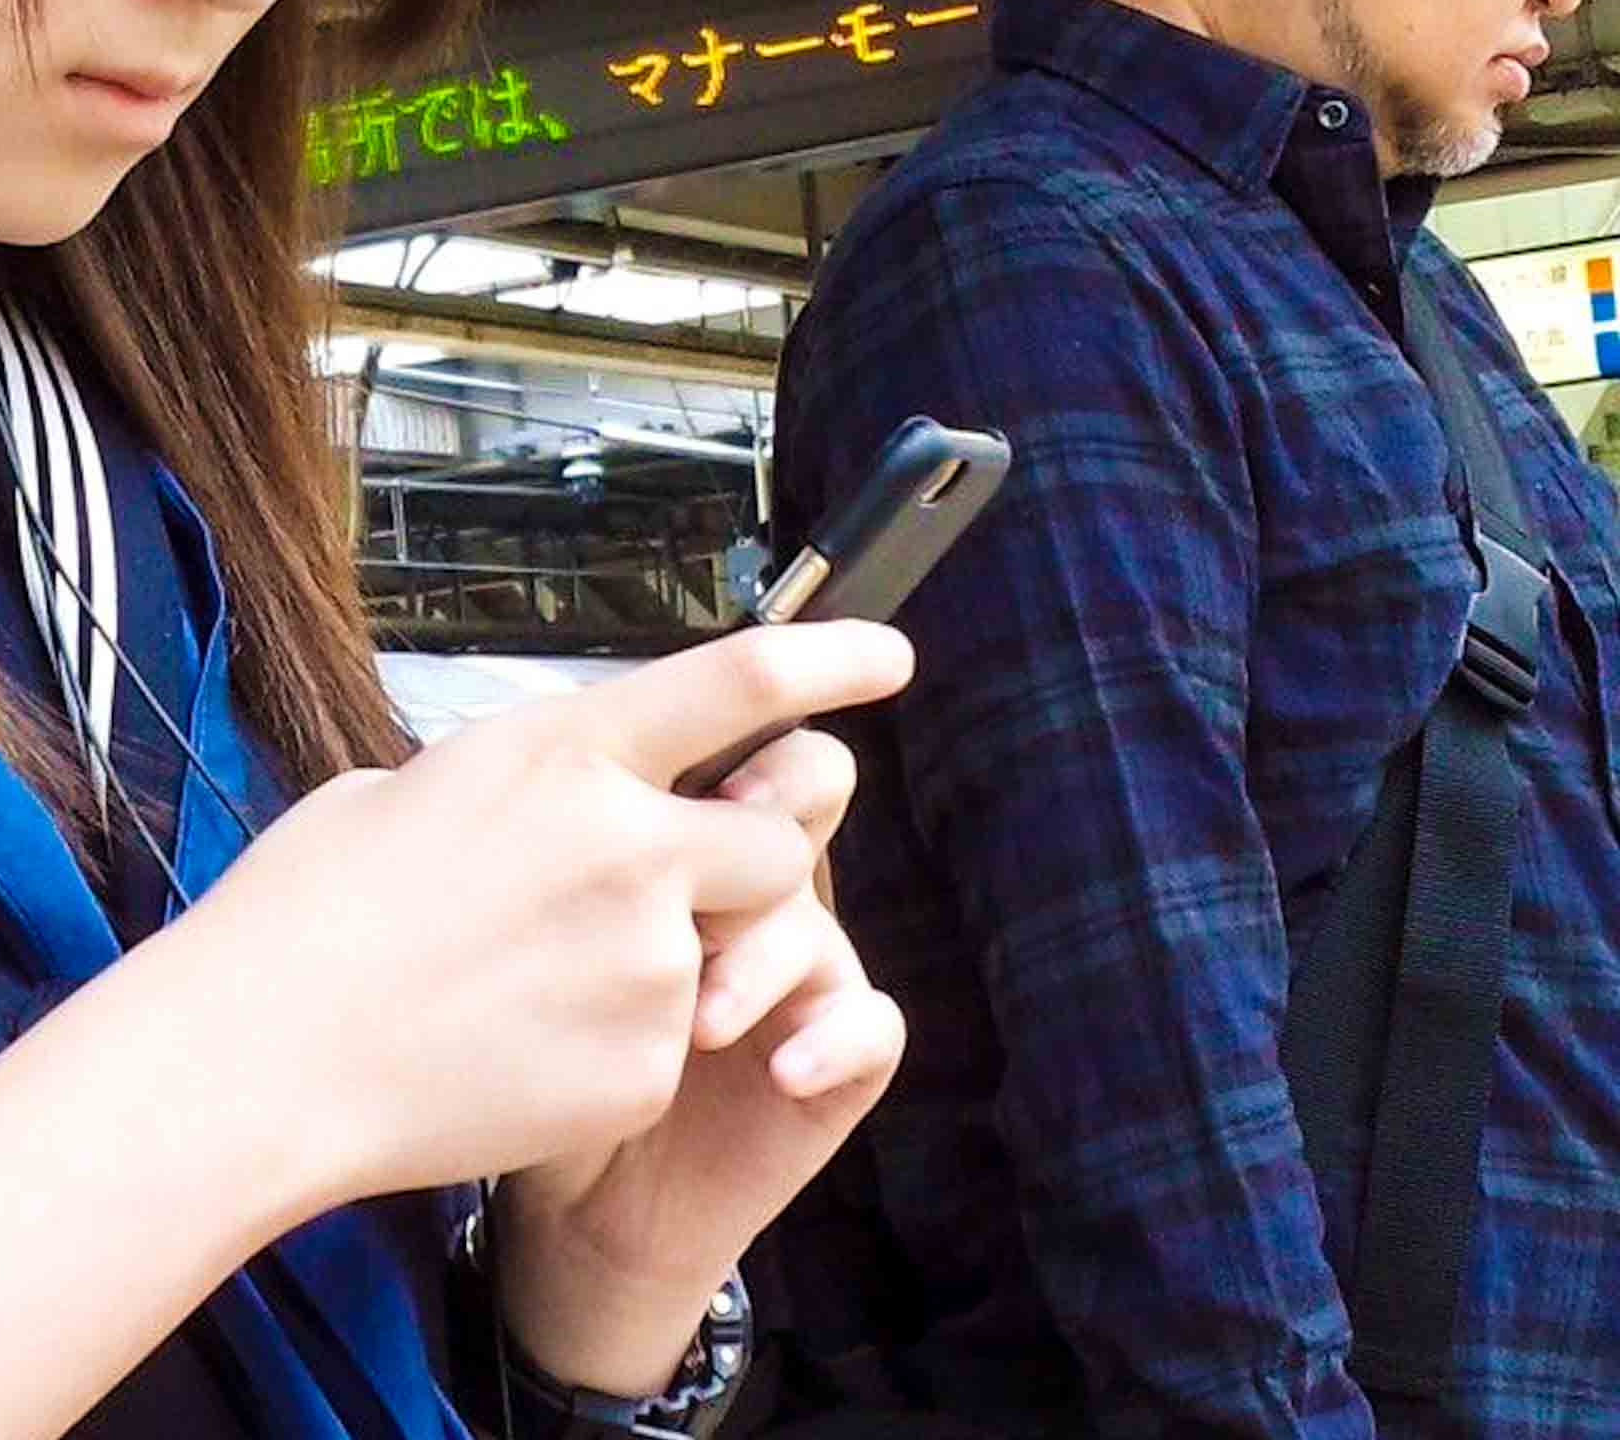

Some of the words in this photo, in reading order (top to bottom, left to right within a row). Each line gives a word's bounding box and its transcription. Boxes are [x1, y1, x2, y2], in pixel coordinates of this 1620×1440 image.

[607, 2, 980, 107] マナーモー
